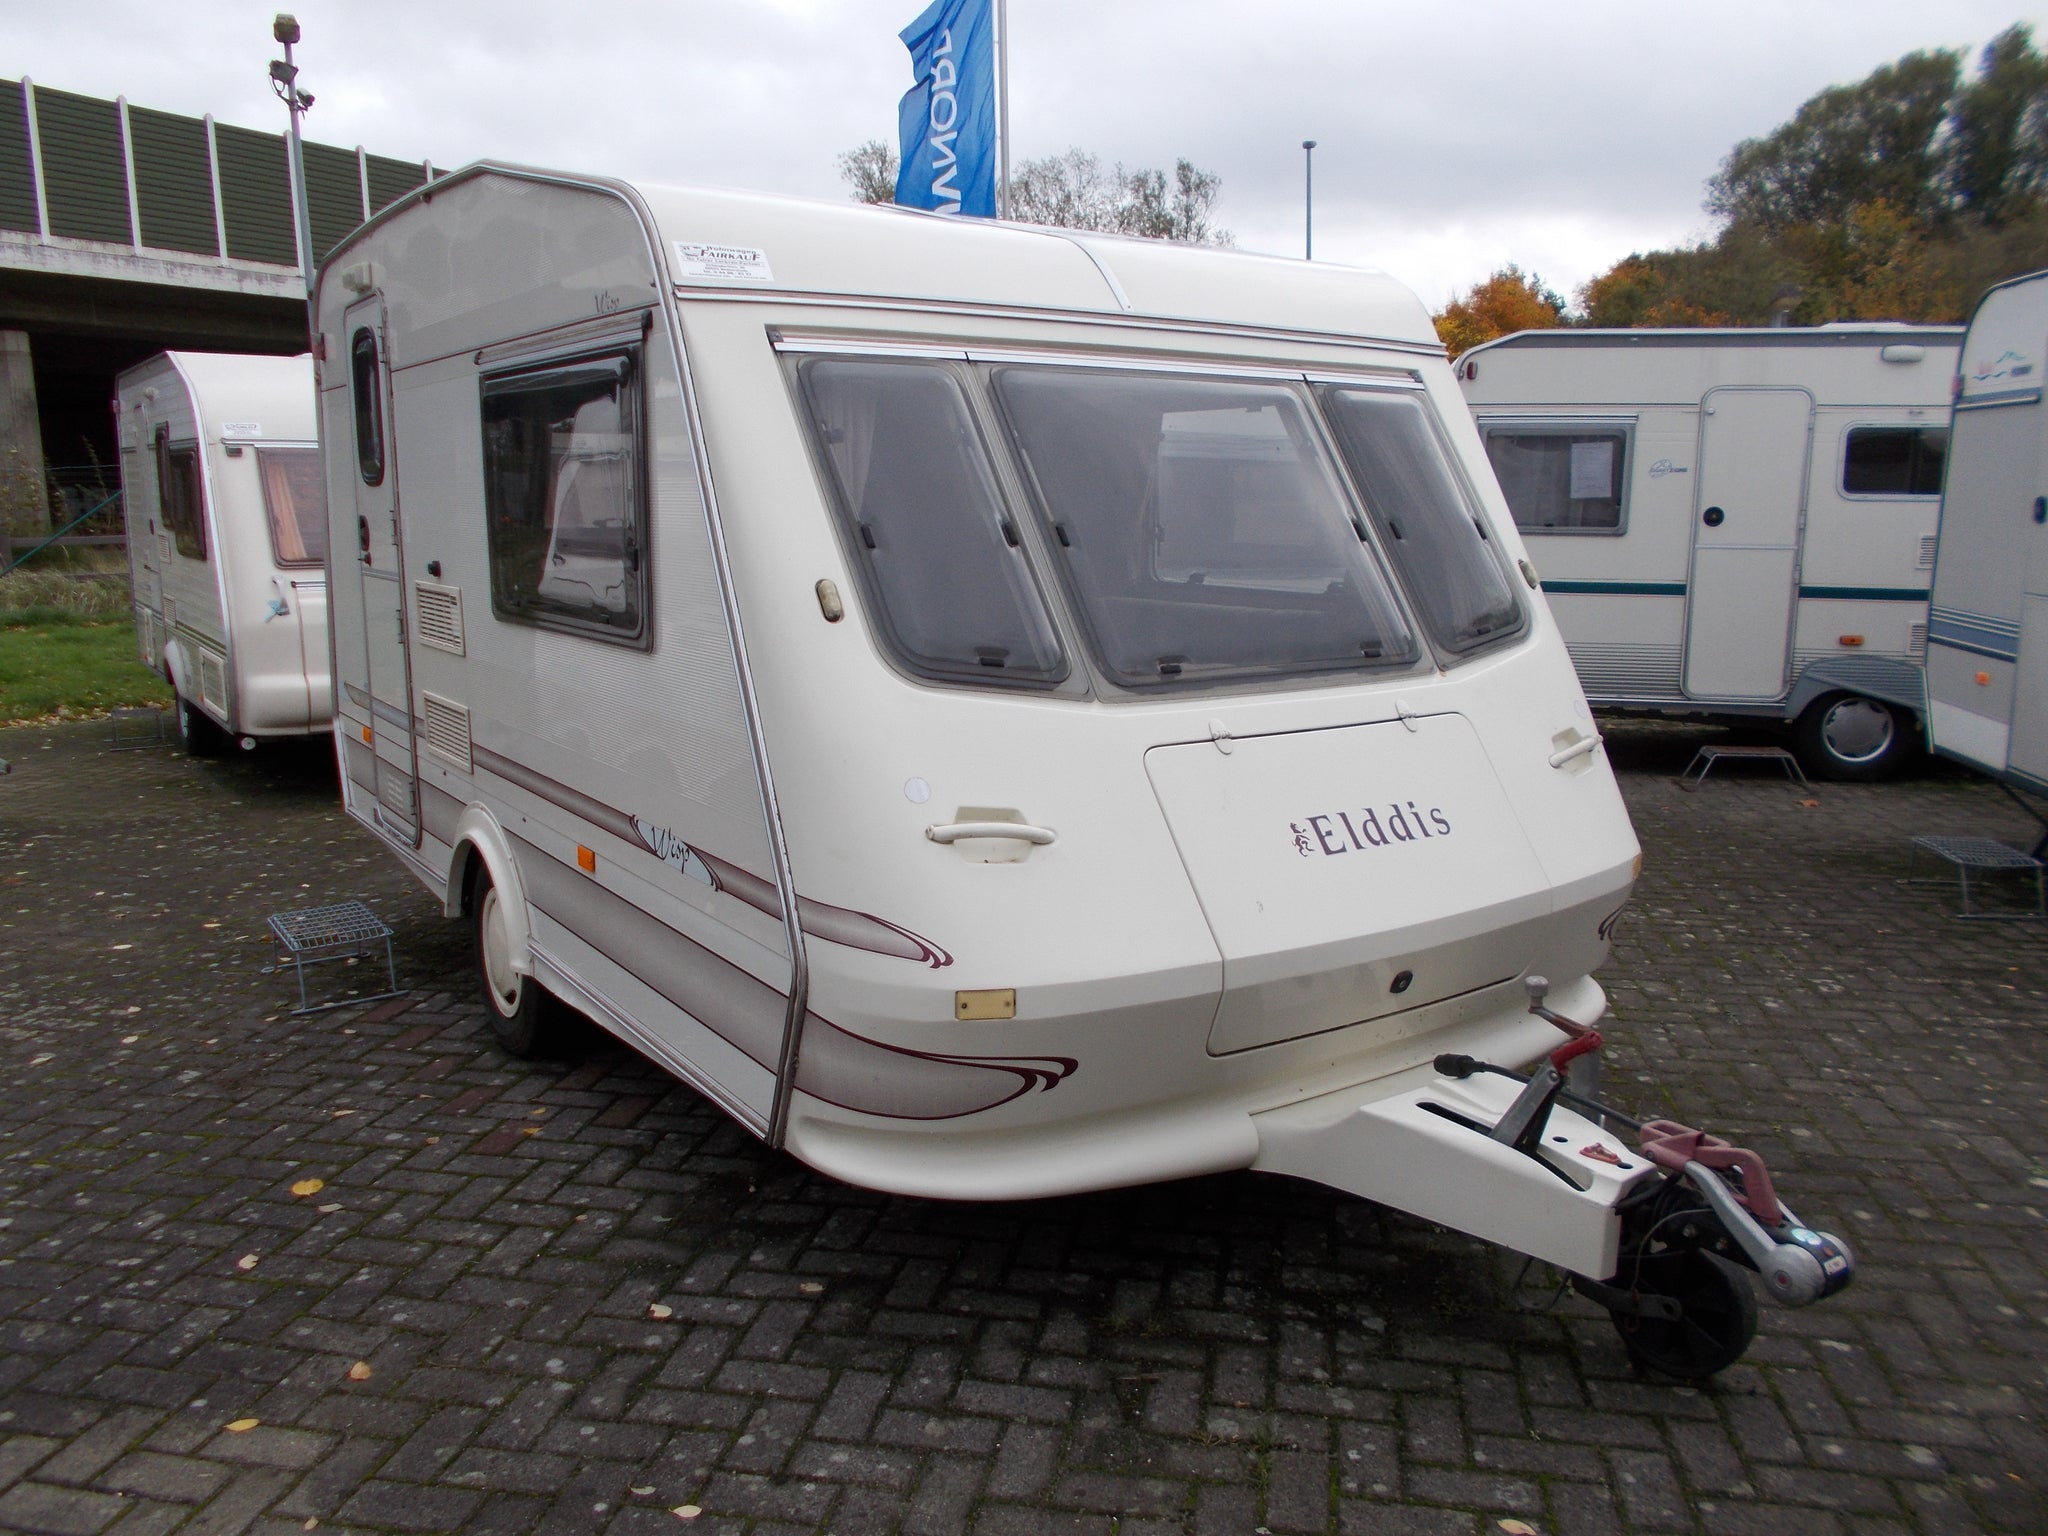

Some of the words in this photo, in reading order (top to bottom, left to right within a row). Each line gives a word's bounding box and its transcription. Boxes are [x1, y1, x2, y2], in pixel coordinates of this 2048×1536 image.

[700, 249, 761, 261] FAIRKAUF
[651, 826, 690, 875] Wisp
[1305, 801, 1451, 856] Elddis
